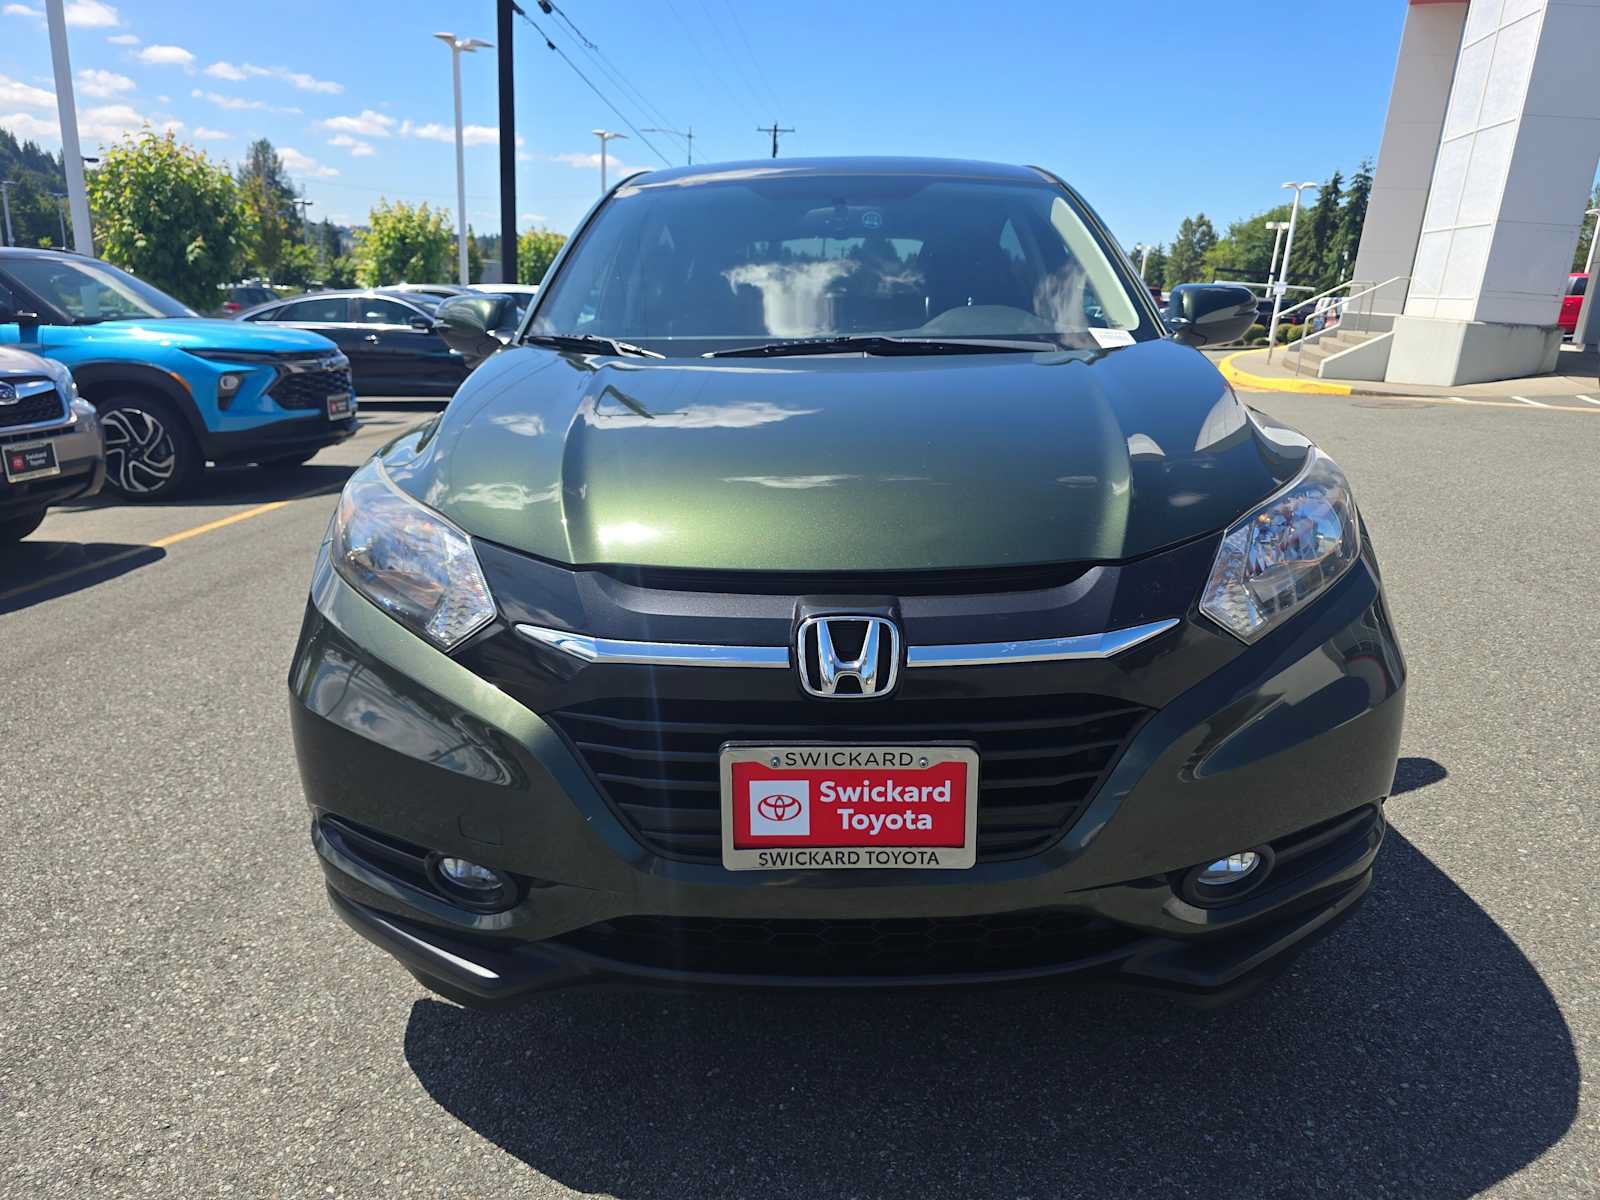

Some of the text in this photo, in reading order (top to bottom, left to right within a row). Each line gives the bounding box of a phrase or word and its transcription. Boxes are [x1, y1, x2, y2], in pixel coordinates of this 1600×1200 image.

[784, 752, 914, 767] SWICKARD
[819, 780, 951, 802] Swickard
[836, 808, 933, 835] Toyota
[758, 851, 940, 866] SWICKARD TOYOTA
